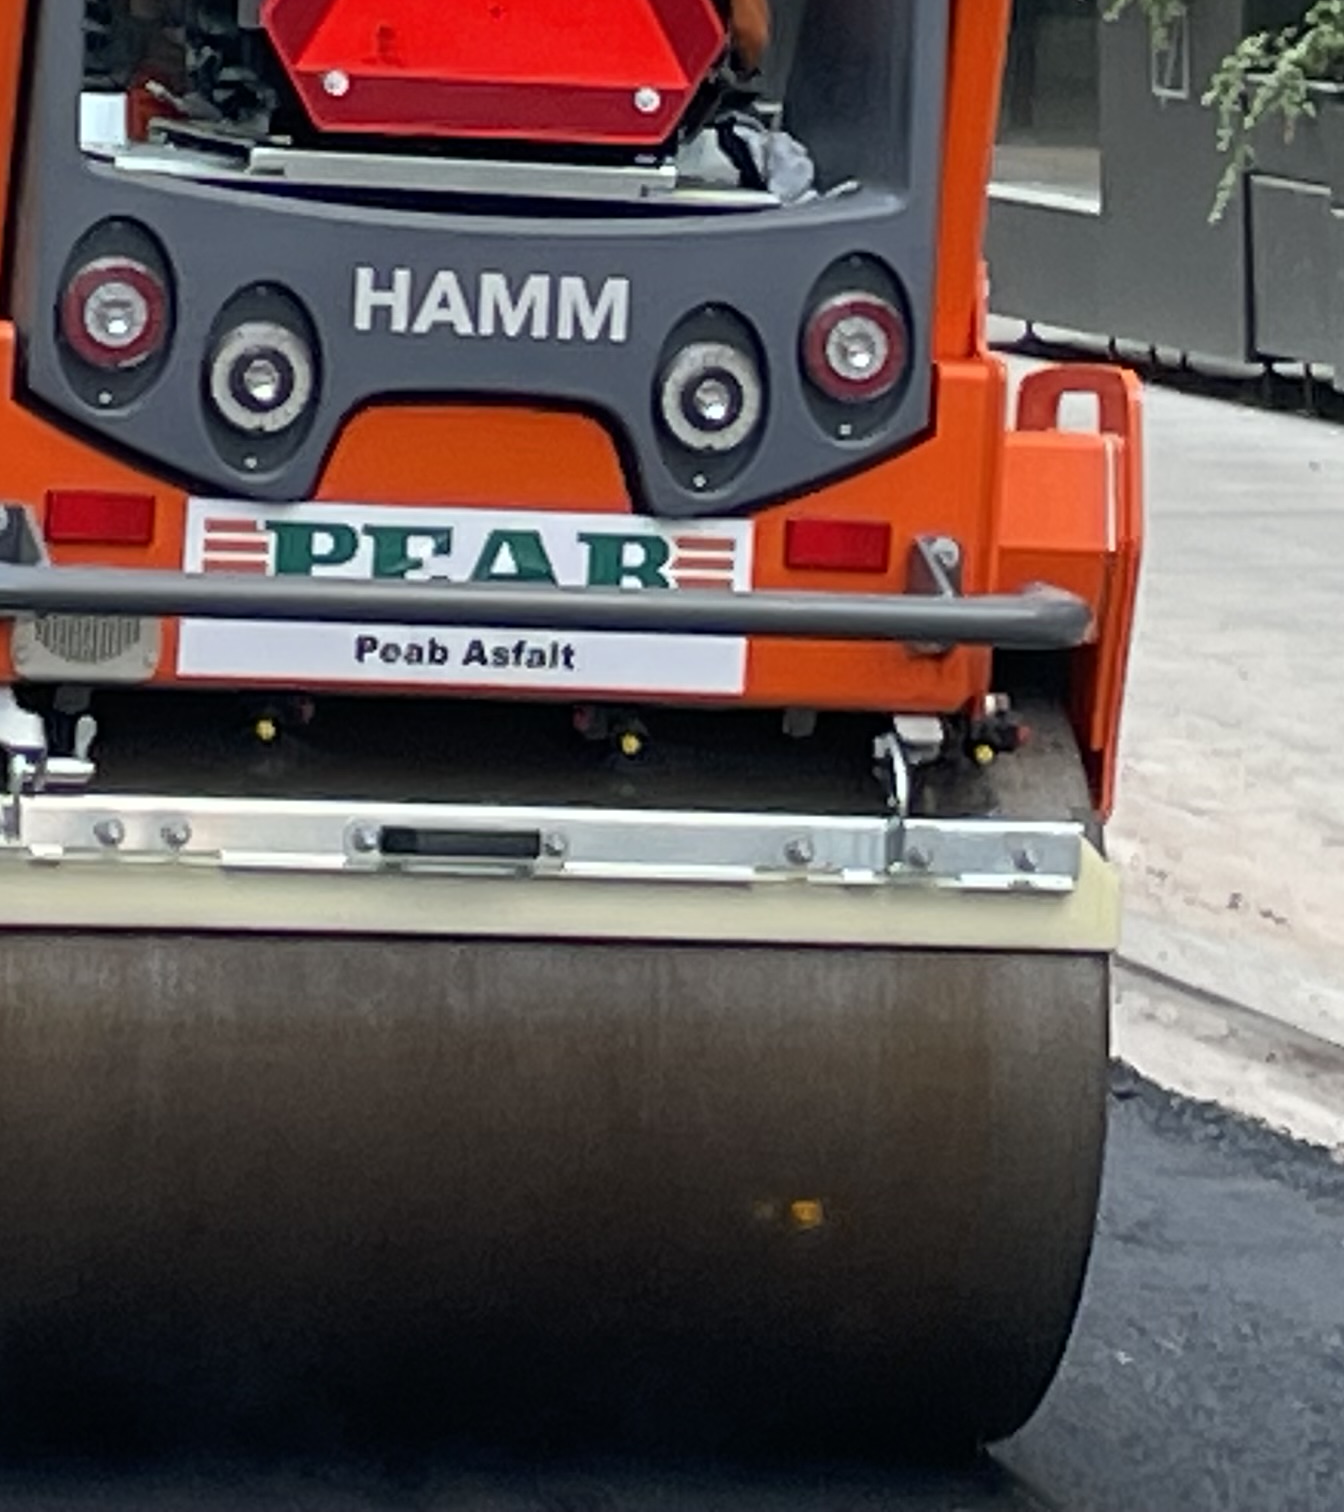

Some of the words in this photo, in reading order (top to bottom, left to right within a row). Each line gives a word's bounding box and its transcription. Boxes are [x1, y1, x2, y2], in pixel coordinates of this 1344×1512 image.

[354, 266, 630, 342] HAMM
[355, 635, 450, 667] Peab
[462, 638, 576, 671] Asfalt
